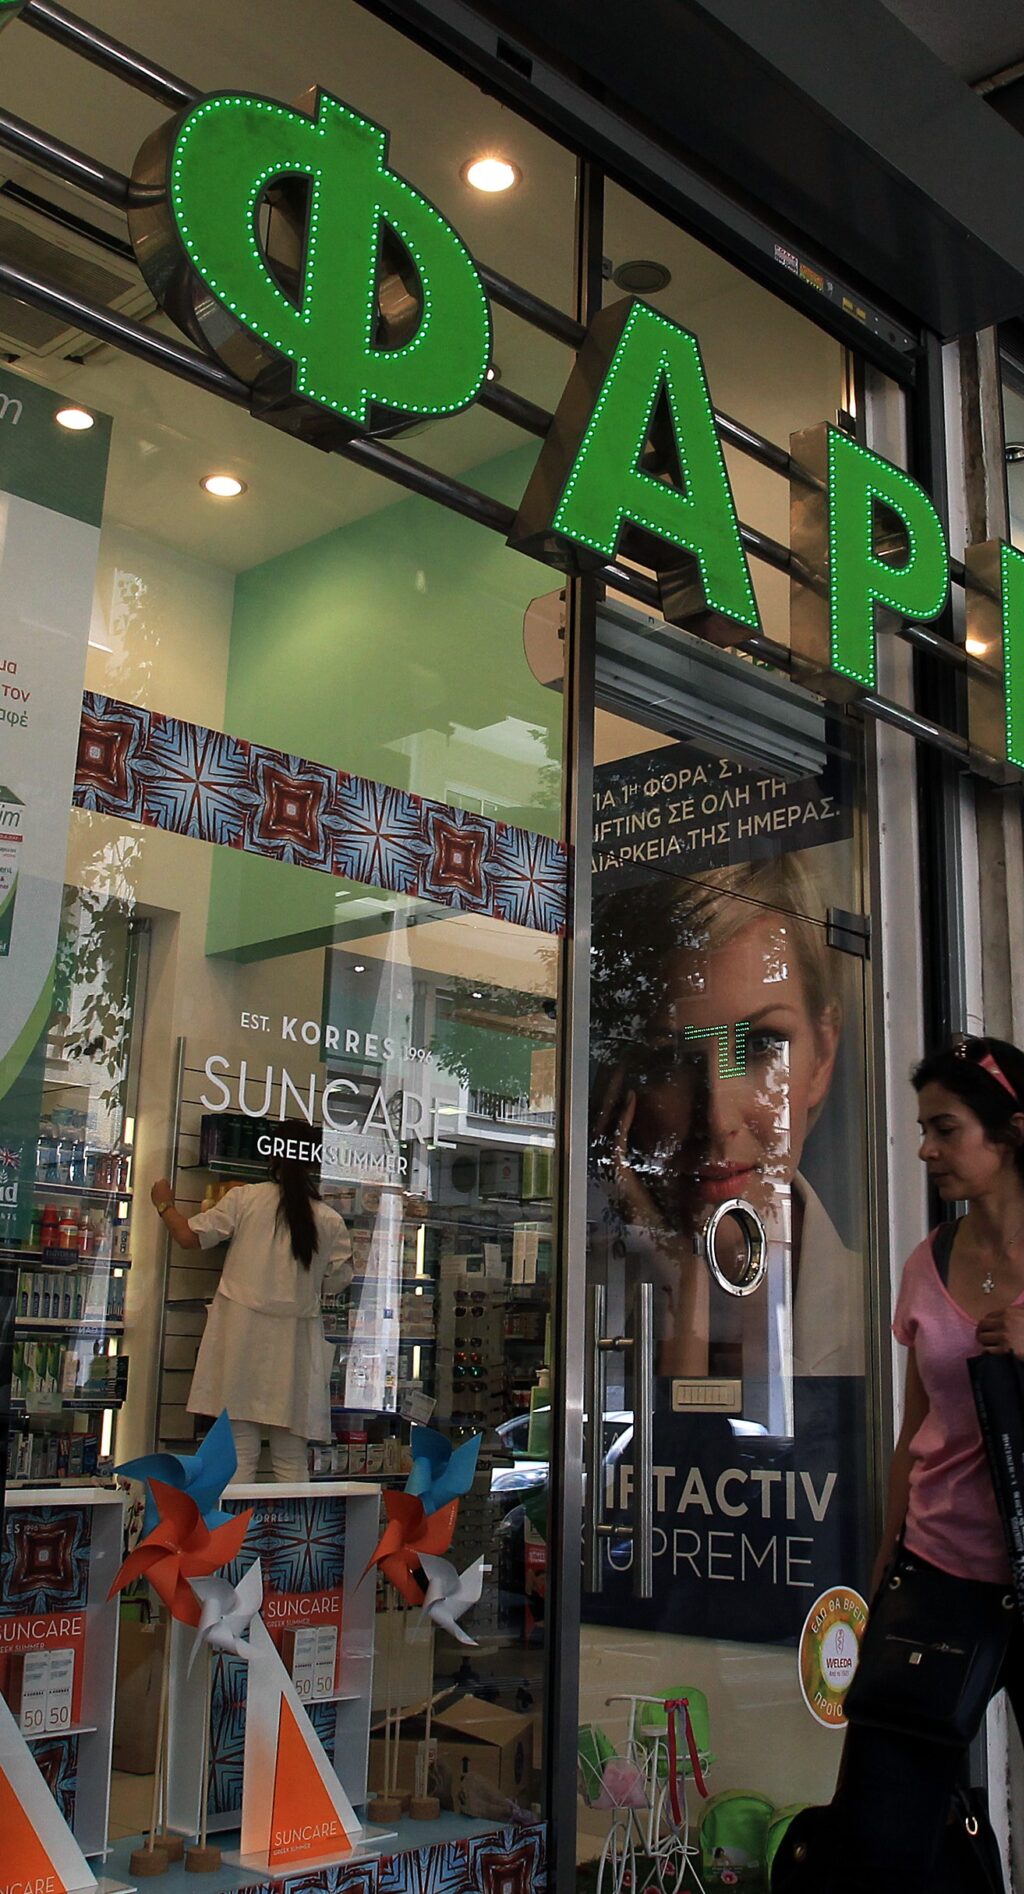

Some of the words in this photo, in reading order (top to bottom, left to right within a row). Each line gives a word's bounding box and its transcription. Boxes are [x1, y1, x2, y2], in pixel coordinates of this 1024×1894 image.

[643, 765, 708, 798] ΦΟΡΑ
[593, 808, 662, 843] IFTING
[701, 785, 751, 815] ΟΛΗ
[687, 822, 731, 850] ΤΗΣ
[737, 796, 841, 839] ΗΜΕΡΑΣ.
[240, 1011, 271, 1032] EST.
[281, 1015, 396, 1060] KORRES
[199, 1054, 457, 1150] SUNCARE
[256, 1134, 322, 1164] GREEK
[323, 1144, 409, 1176] SUMMER
[582, 1463, 838, 1522] IFTACTIV
[580, 1527, 814, 1587] UPREME
[267, 1596, 340, 1618] SUNCARE
[826, 1658, 852, 1669] WELEDA
[316, 1676, 332, 1692] 50
[24, 1709, 43, 1728] 50
[50, 1706, 69, 1725] 50
[274, 1820, 338, 1846] SUNCARE
